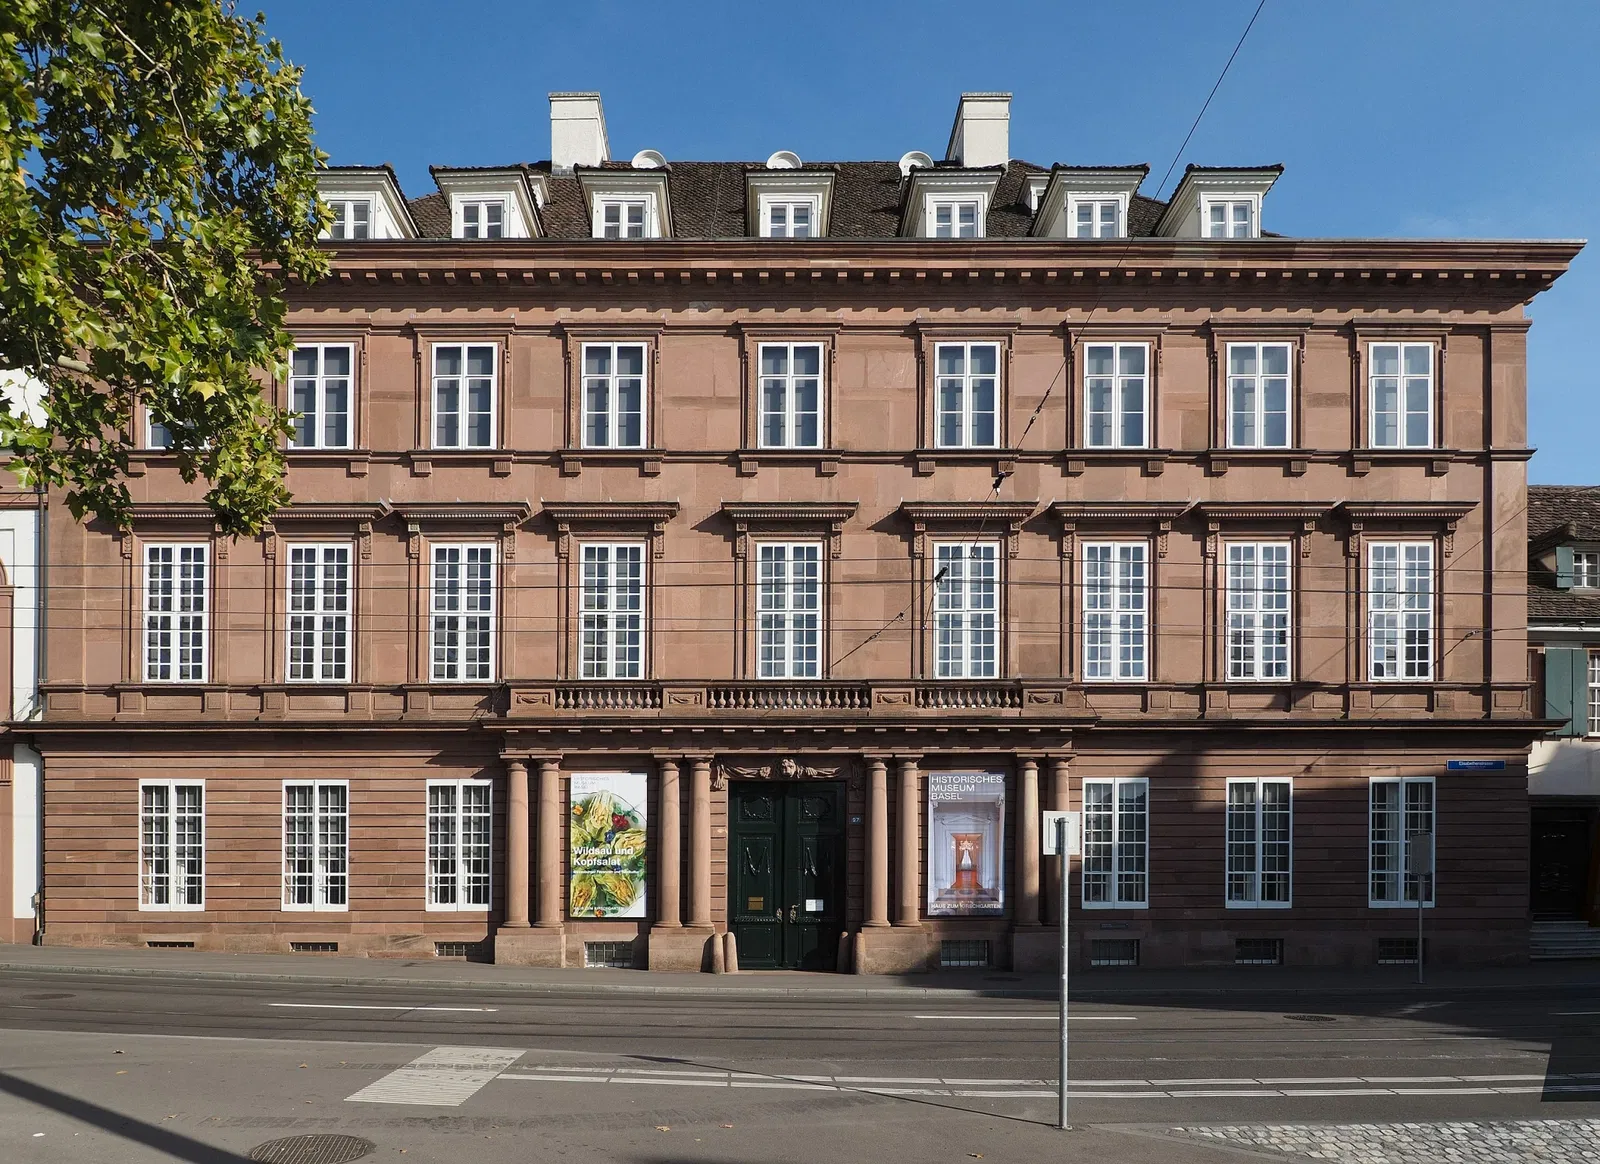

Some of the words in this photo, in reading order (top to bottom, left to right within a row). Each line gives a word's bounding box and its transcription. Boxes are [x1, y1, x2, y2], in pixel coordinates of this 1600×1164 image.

[931, 775, 1003, 783] HISTORISCHES
[931, 792, 963, 800] BASEL
[573, 846, 612, 854] Wildsau
[615, 846, 634, 854] und
[573, 857, 621, 867] Kopfsalat
